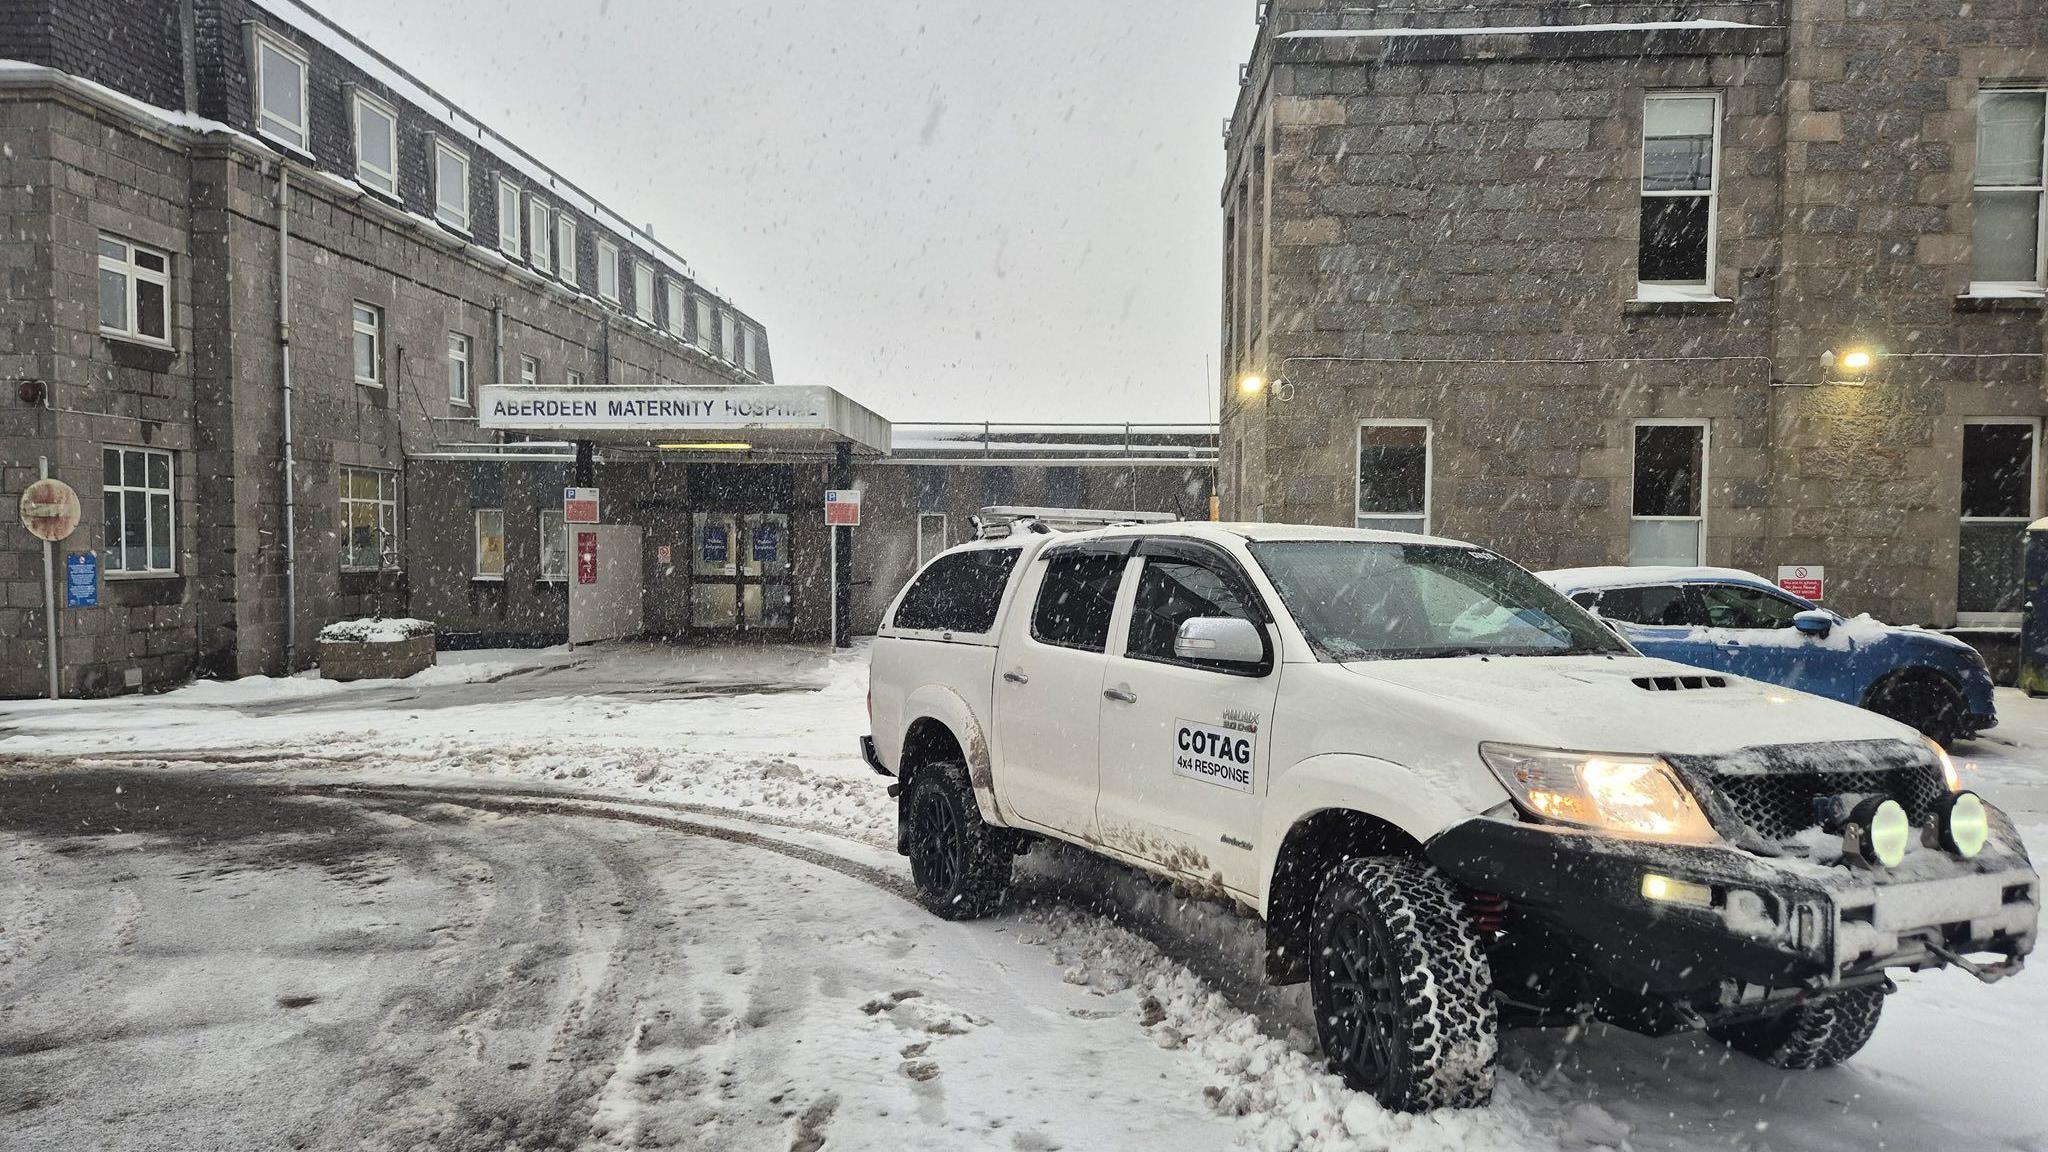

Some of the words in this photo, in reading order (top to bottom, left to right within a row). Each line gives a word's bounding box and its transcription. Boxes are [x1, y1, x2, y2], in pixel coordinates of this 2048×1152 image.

[494, 400, 597, 417] ABERDEEN
[608, 400, 714, 417] MATERNITY
[1178, 727, 1250, 764] COTAG
[1177, 755, 1193, 769] 4x4
[1195, 759, 1249, 784] RESPONSE
